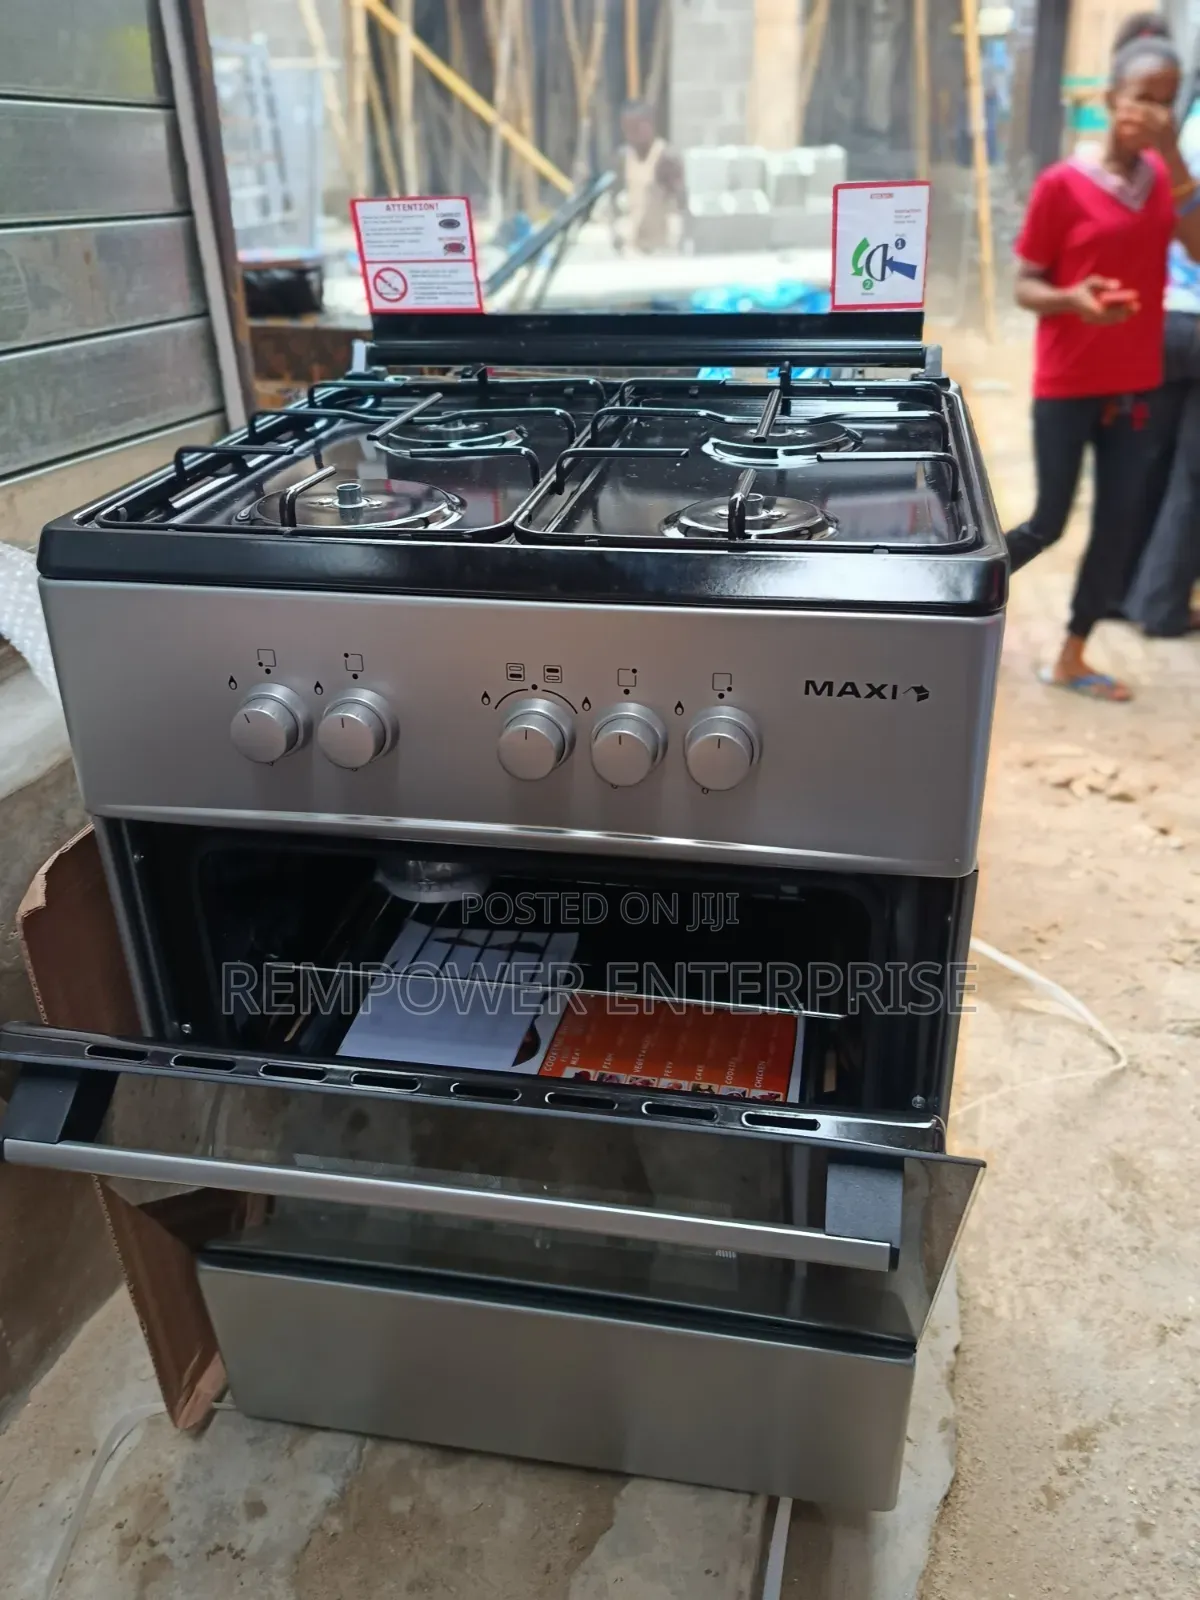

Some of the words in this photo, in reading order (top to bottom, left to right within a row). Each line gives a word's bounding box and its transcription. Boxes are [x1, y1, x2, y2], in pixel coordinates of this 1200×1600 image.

[385, 202, 439, 212] ATTENTION!
[804, 679, 898, 701] MAXI
[754, 1060, 766, 1088] CHICKEN
